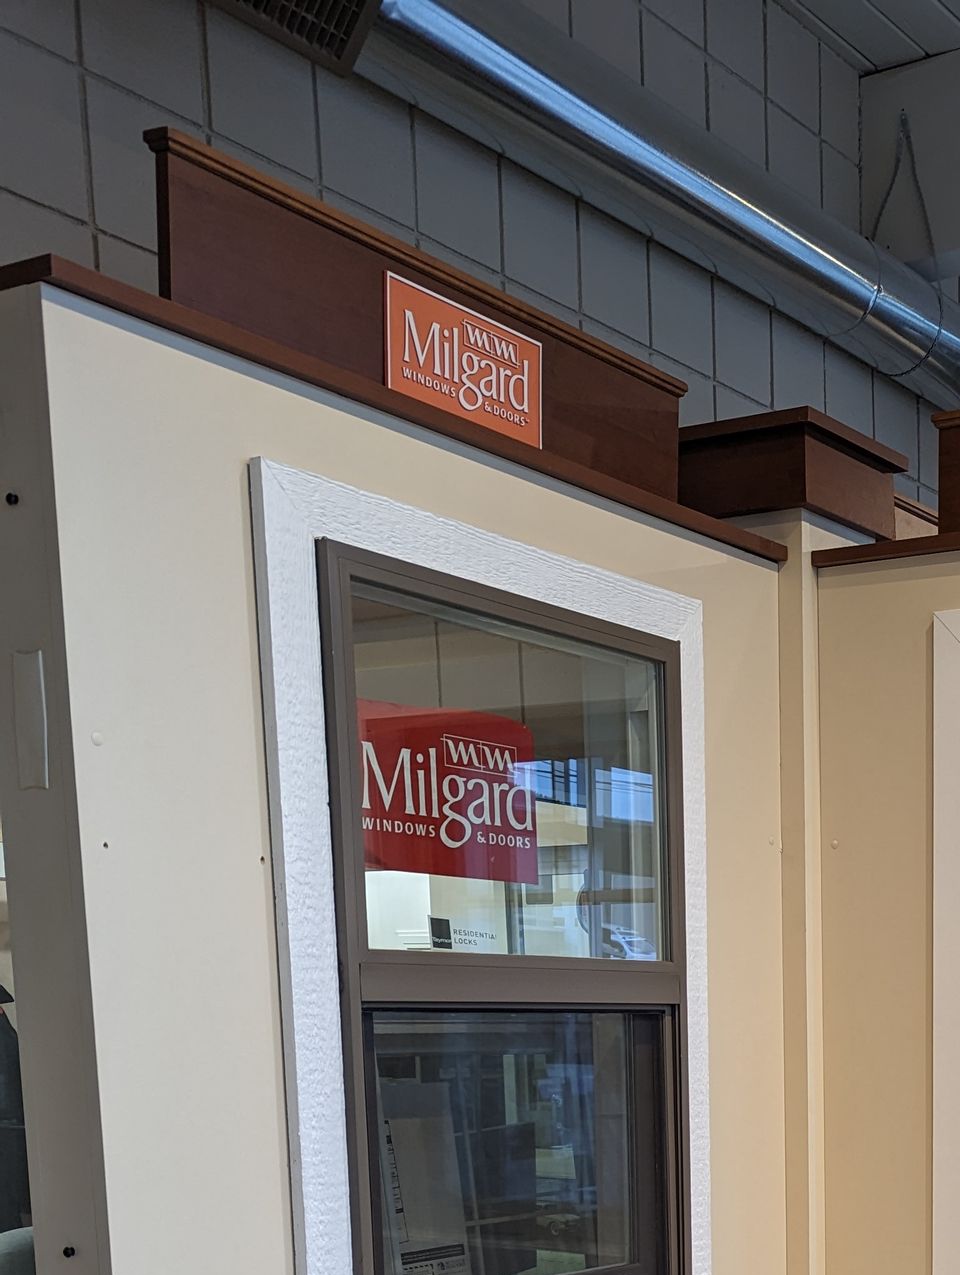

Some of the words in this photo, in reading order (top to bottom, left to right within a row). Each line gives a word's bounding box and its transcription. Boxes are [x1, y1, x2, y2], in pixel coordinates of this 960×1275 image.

[403, 309, 529, 413] Milgard
[402, 367, 456, 398] WINDOWS
[484, 401, 493, 413] &
[361, 740, 533, 848] Milgard
[362, 816, 436, 837] WINDOWS
[477, 831, 487, 844] &
[489, 833, 531, 848] DOORS
[454, 938, 477, 946] LOCKS
